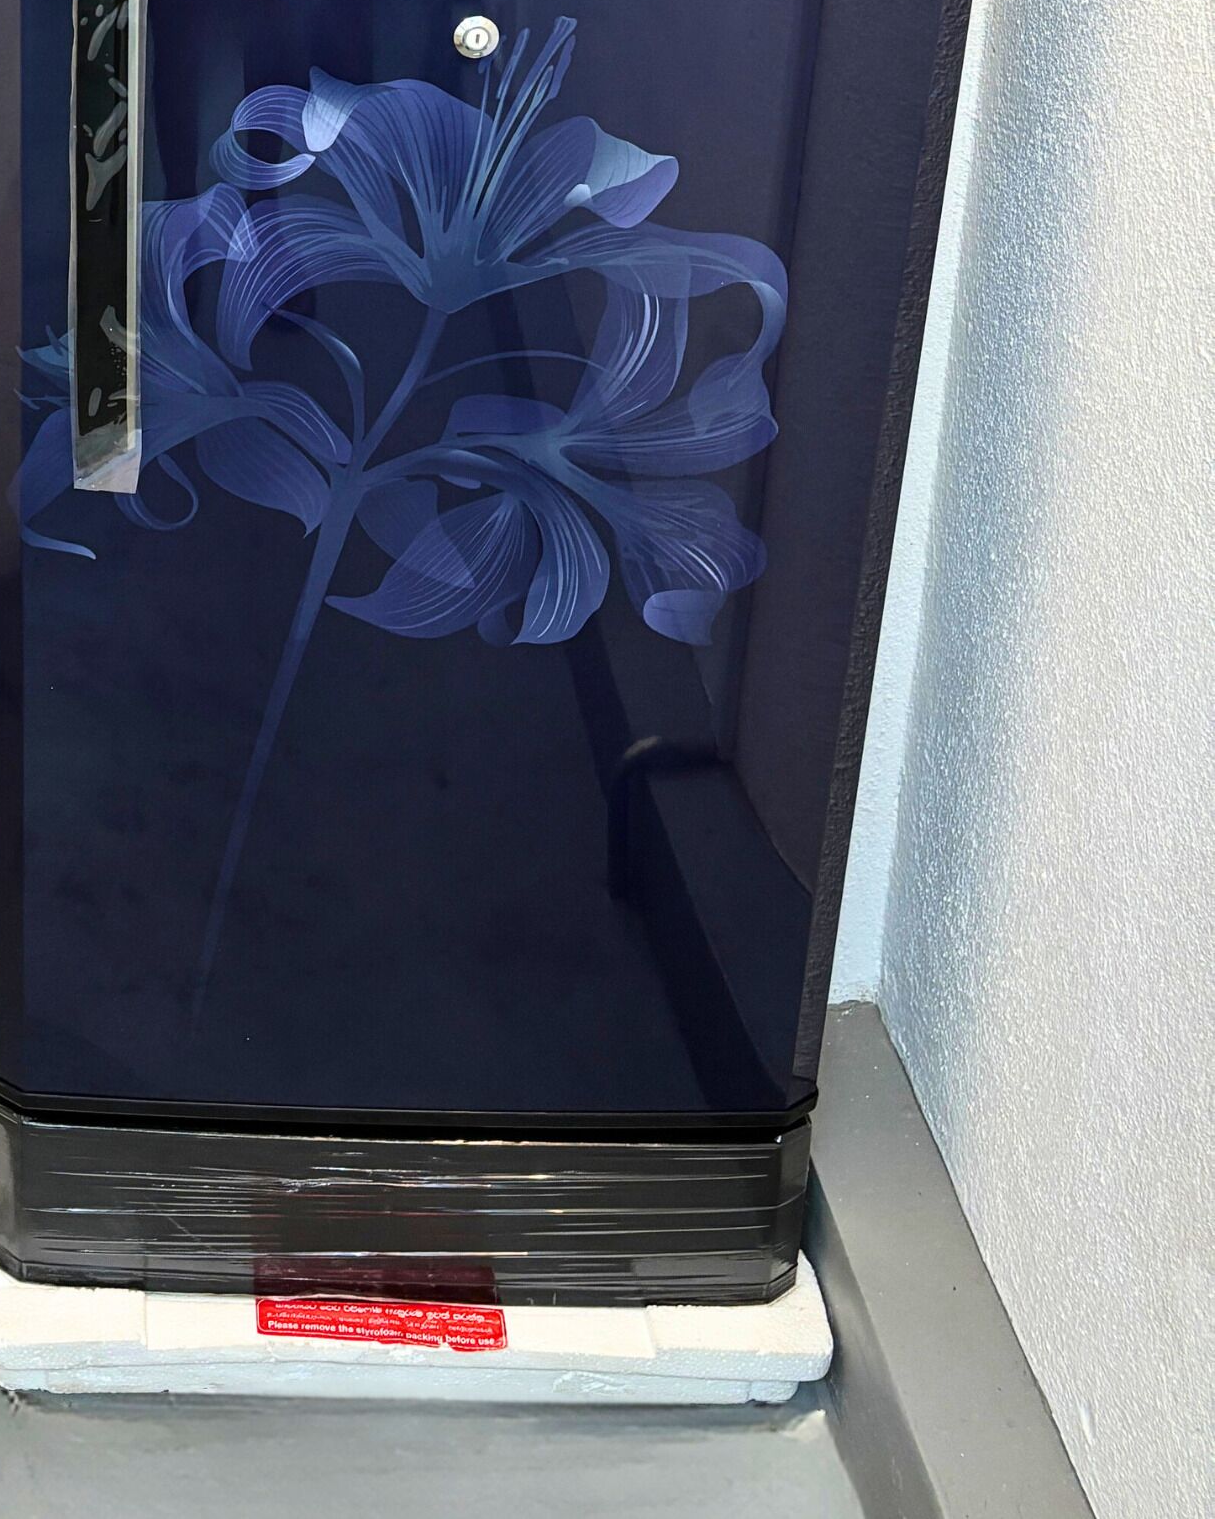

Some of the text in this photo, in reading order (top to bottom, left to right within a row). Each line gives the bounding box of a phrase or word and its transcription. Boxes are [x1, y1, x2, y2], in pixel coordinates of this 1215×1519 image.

[267, 1320, 298, 1330] Please
[301, 1323, 336, 1332] remove
[338, 1324, 354, 1332] the
[445, 1334, 475, 1344] before
